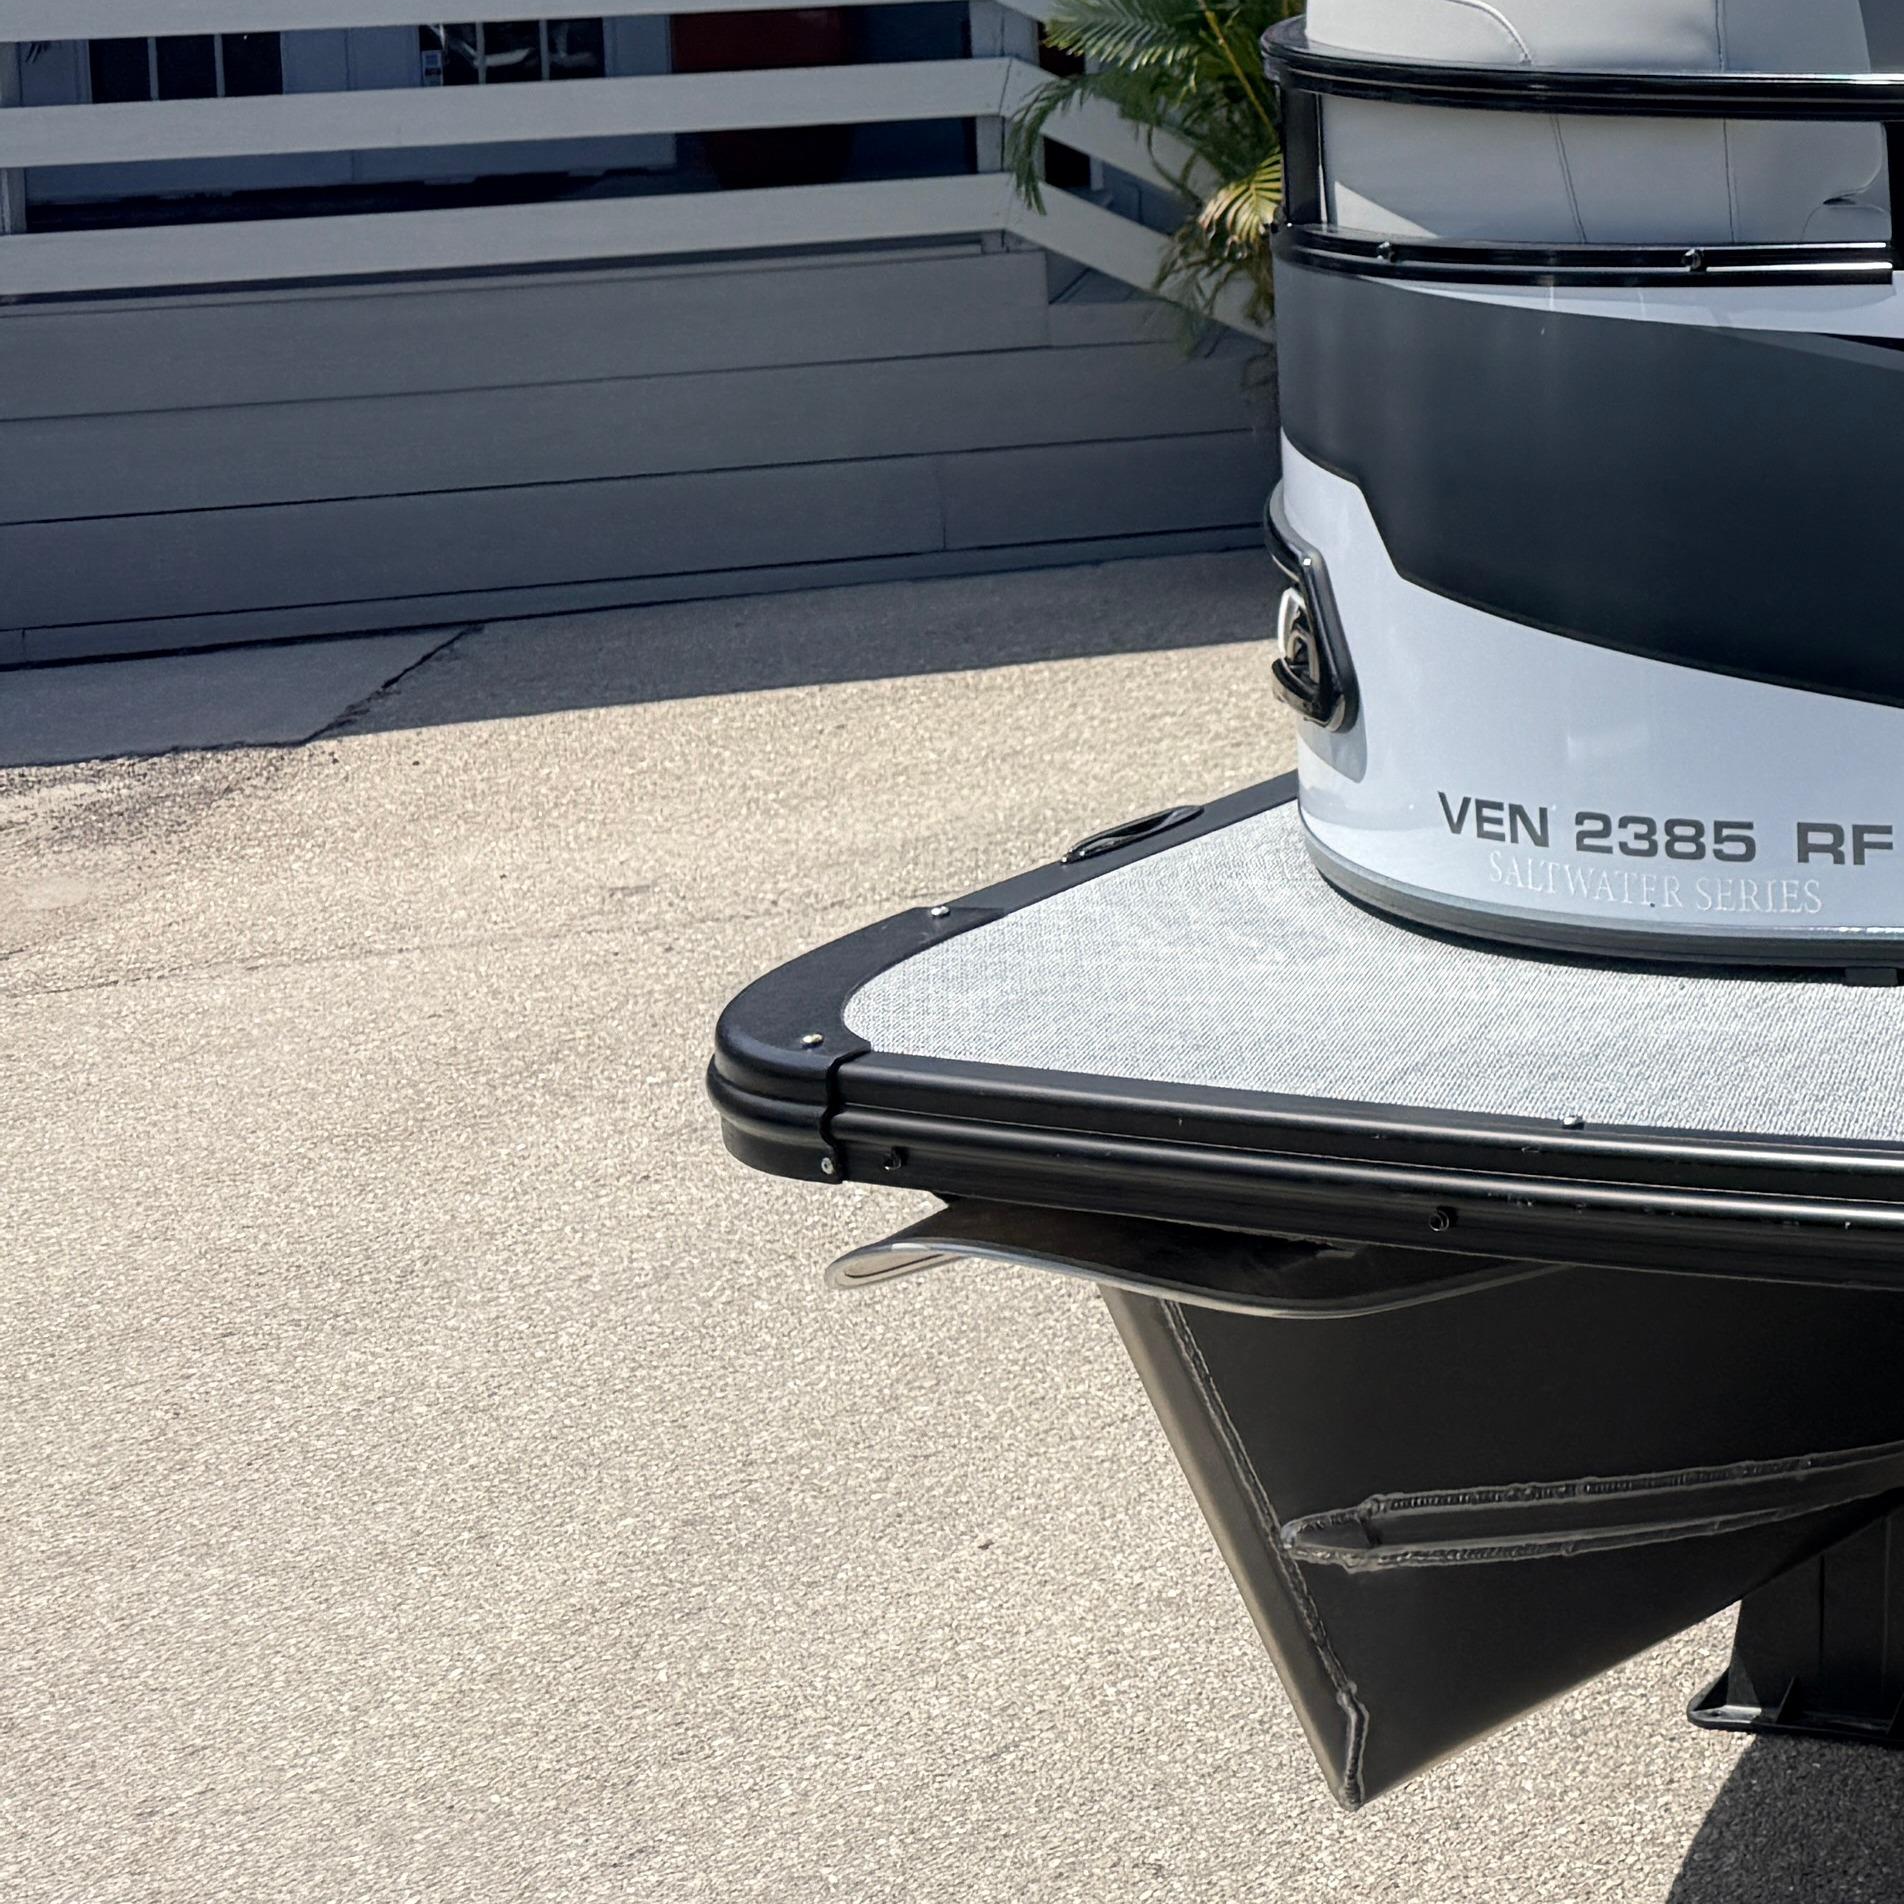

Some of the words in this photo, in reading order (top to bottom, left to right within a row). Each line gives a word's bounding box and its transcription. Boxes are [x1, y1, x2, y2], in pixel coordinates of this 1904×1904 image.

[1437, 790, 1550, 849] VEN
[1574, 810, 1757, 863] 2385
[1796, 821, 1894, 866] RF
[1488, 849, 1684, 910] SALTWATER
[1695, 877, 1824, 914] SERIES
